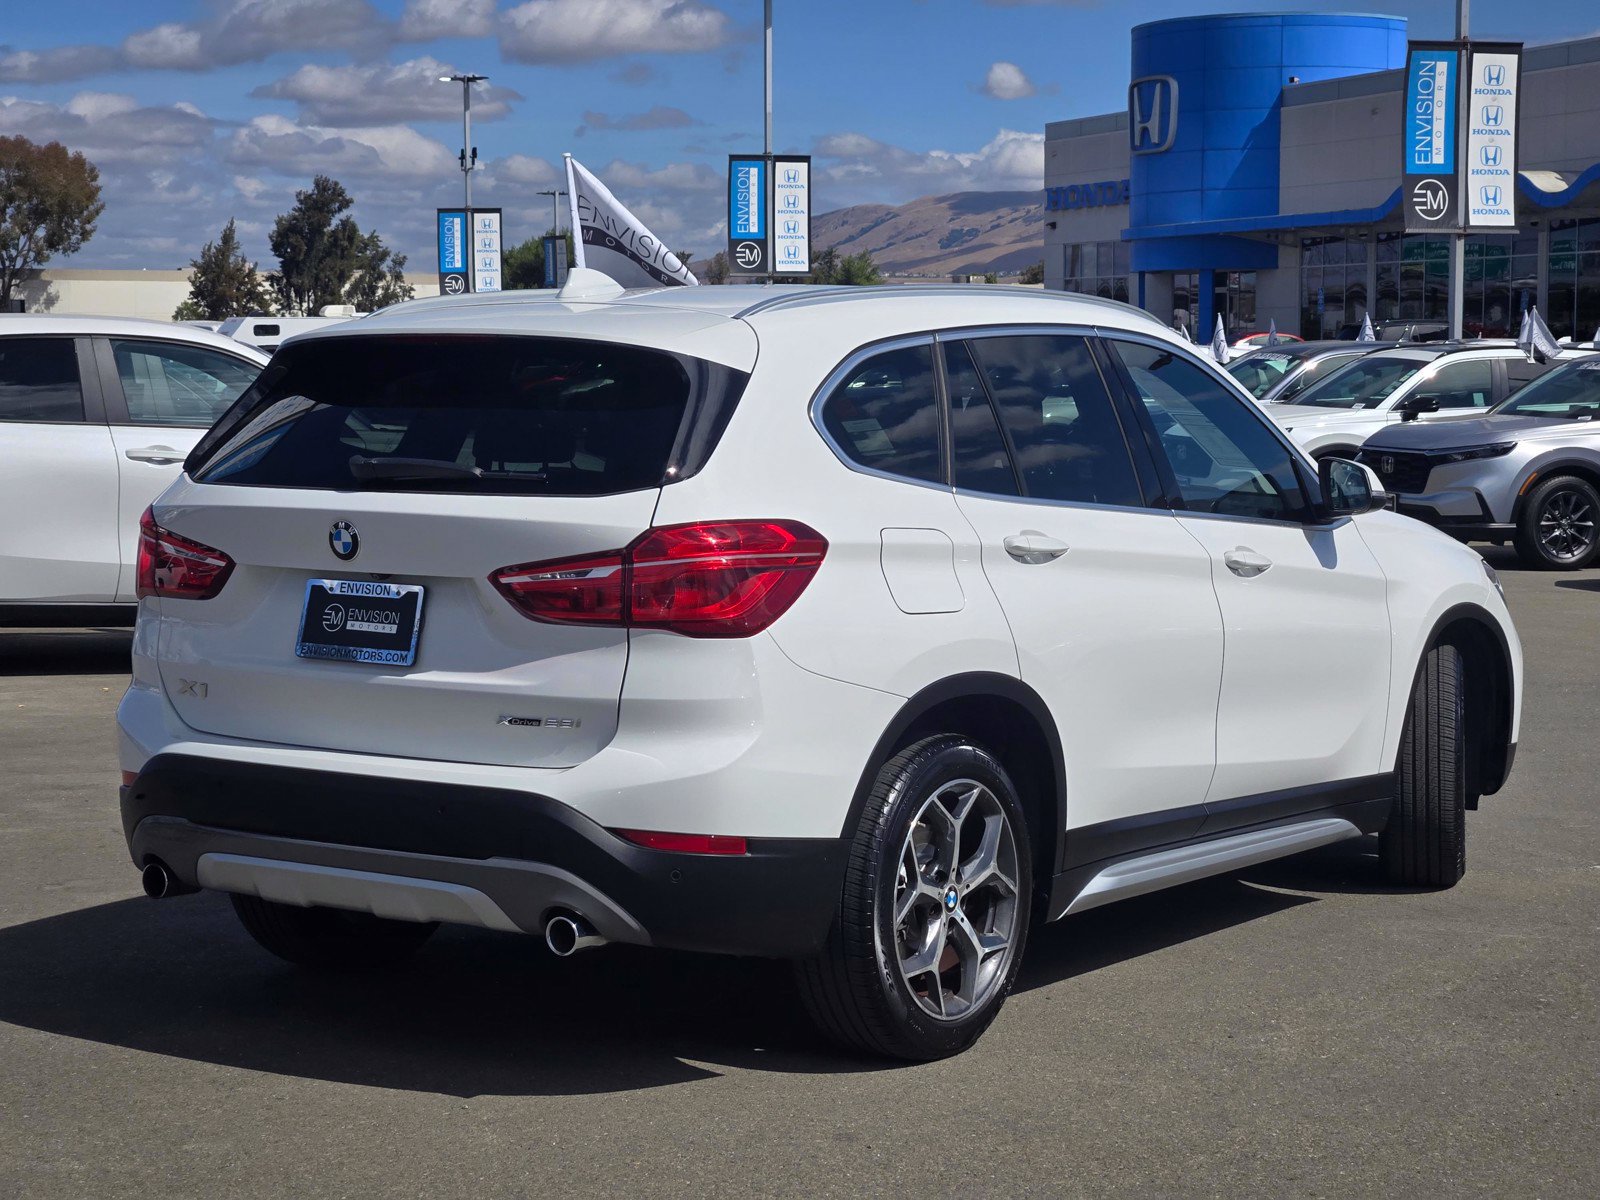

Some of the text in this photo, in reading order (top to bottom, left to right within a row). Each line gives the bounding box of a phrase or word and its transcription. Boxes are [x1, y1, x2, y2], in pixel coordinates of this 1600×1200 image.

[1474, 88, 1512, 96] HONDA
[1415, 60, 1435, 165] ENVISION
[1434, 70, 1445, 156] MOTORS
[1472, 128, 1511, 136] HONDA
[737, 167, 749, 233] ENVISION
[1472, 208, 1510, 216] HONDA
[445, 217, 454, 268] ENVISION
[583, 229, 668, 283] MOTOR
[340, 582, 391, 597] ENVISION
[348, 608, 400, 624] ENVISION
[350, 622, 394, 633] MOTORS
[301, 645, 409, 664] ENVISIONMOTORS.COM
[177, 678, 209, 699] X1
